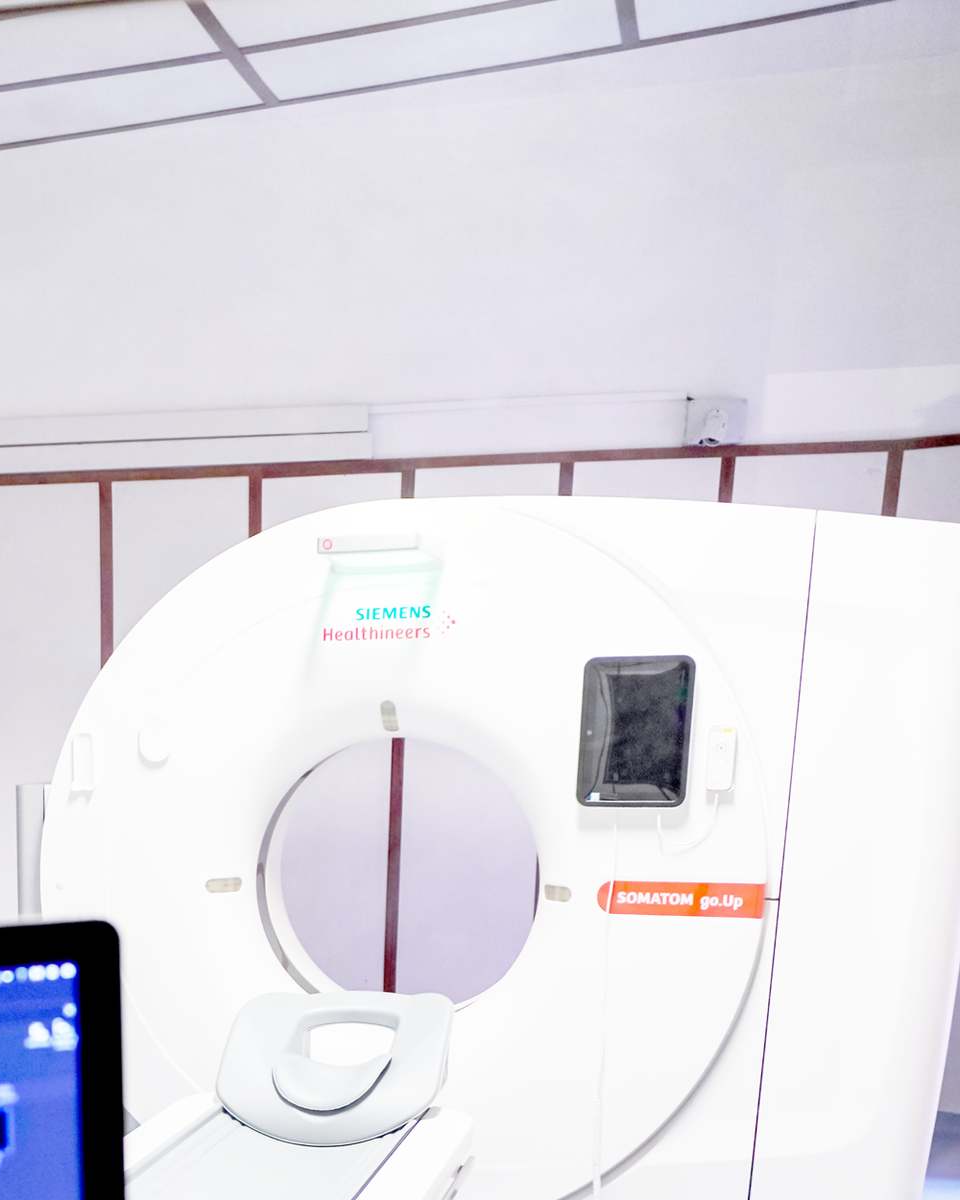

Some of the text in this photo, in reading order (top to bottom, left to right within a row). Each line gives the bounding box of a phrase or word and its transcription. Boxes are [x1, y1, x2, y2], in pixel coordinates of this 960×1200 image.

[356, 605, 431, 621] SIEMENS
[323, 625, 431, 641] Healthineers
[616, 891, 744, 910] SOMATOM go.Up
